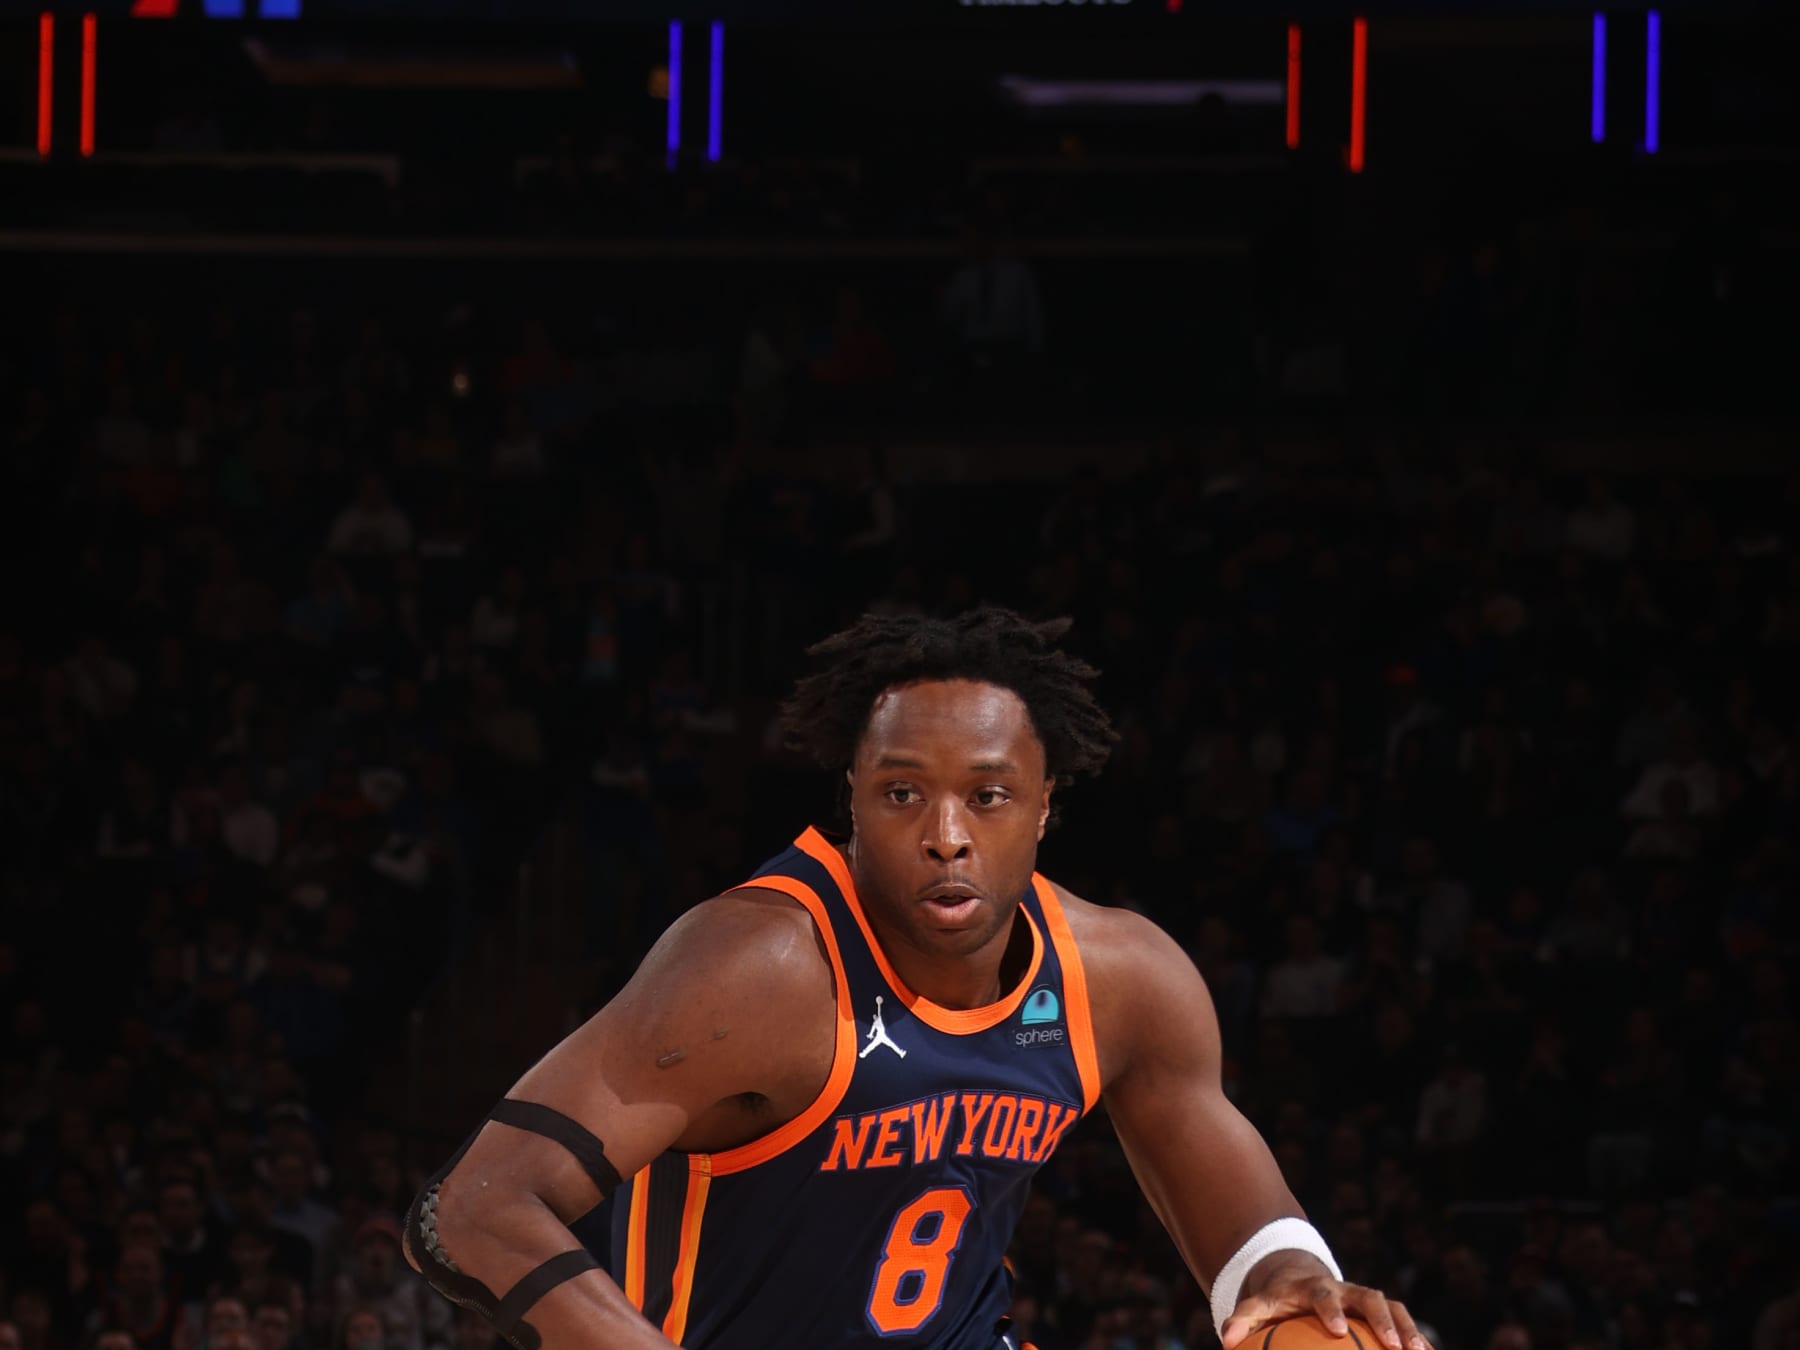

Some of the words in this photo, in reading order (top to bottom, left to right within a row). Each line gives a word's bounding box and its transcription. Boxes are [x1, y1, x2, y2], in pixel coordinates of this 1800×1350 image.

[1014, 1026, 1064, 1047] sphere
[819, 1093, 956, 1172] NEW
[955, 1091, 1080, 1163] YORK
[865, 1184, 978, 1337] 8
